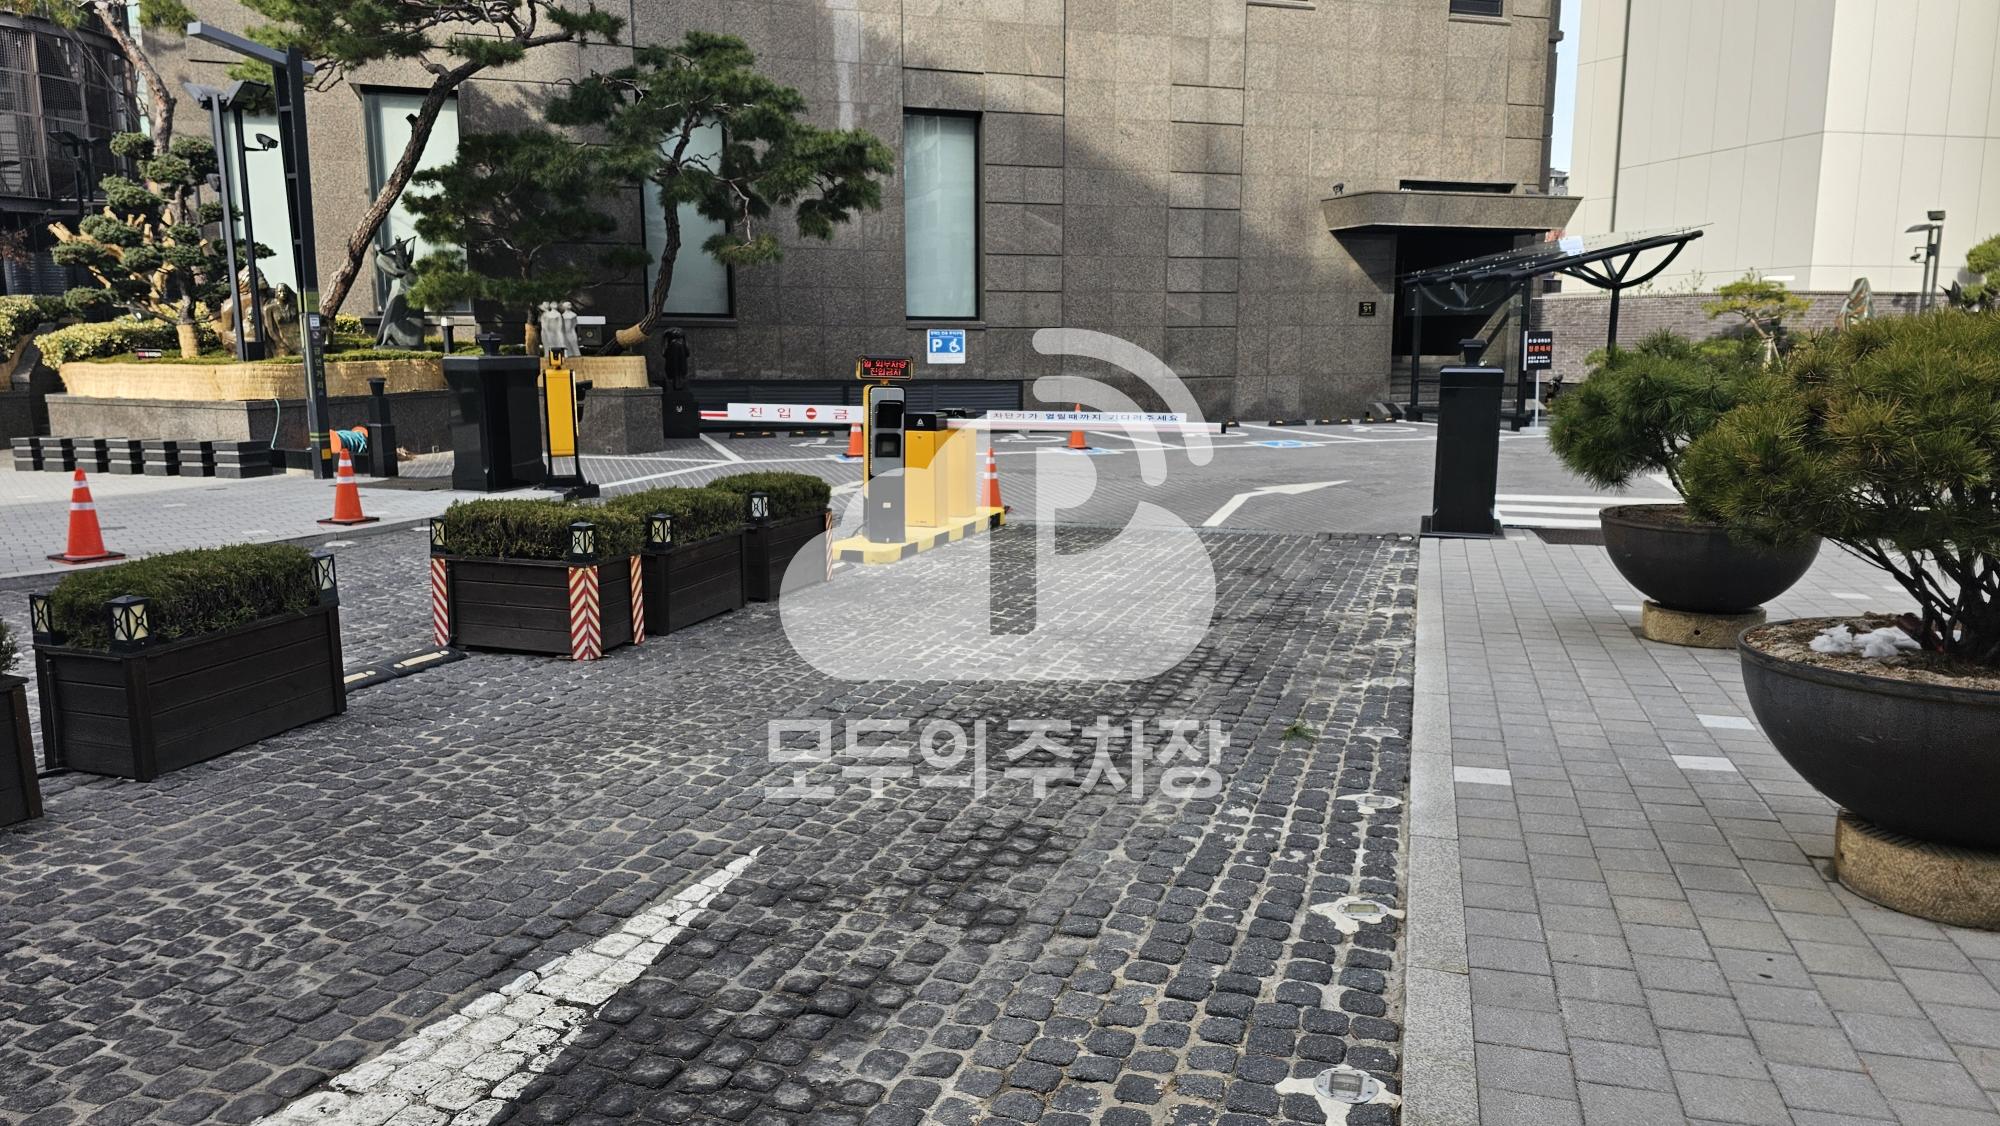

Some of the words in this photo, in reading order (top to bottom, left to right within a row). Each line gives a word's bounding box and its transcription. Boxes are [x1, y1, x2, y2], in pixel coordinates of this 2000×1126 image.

[932, 338, 943, 352] P
[870, 367, 901, 376] 진입금지
[993, 412, 1038, 420] 차단기가
